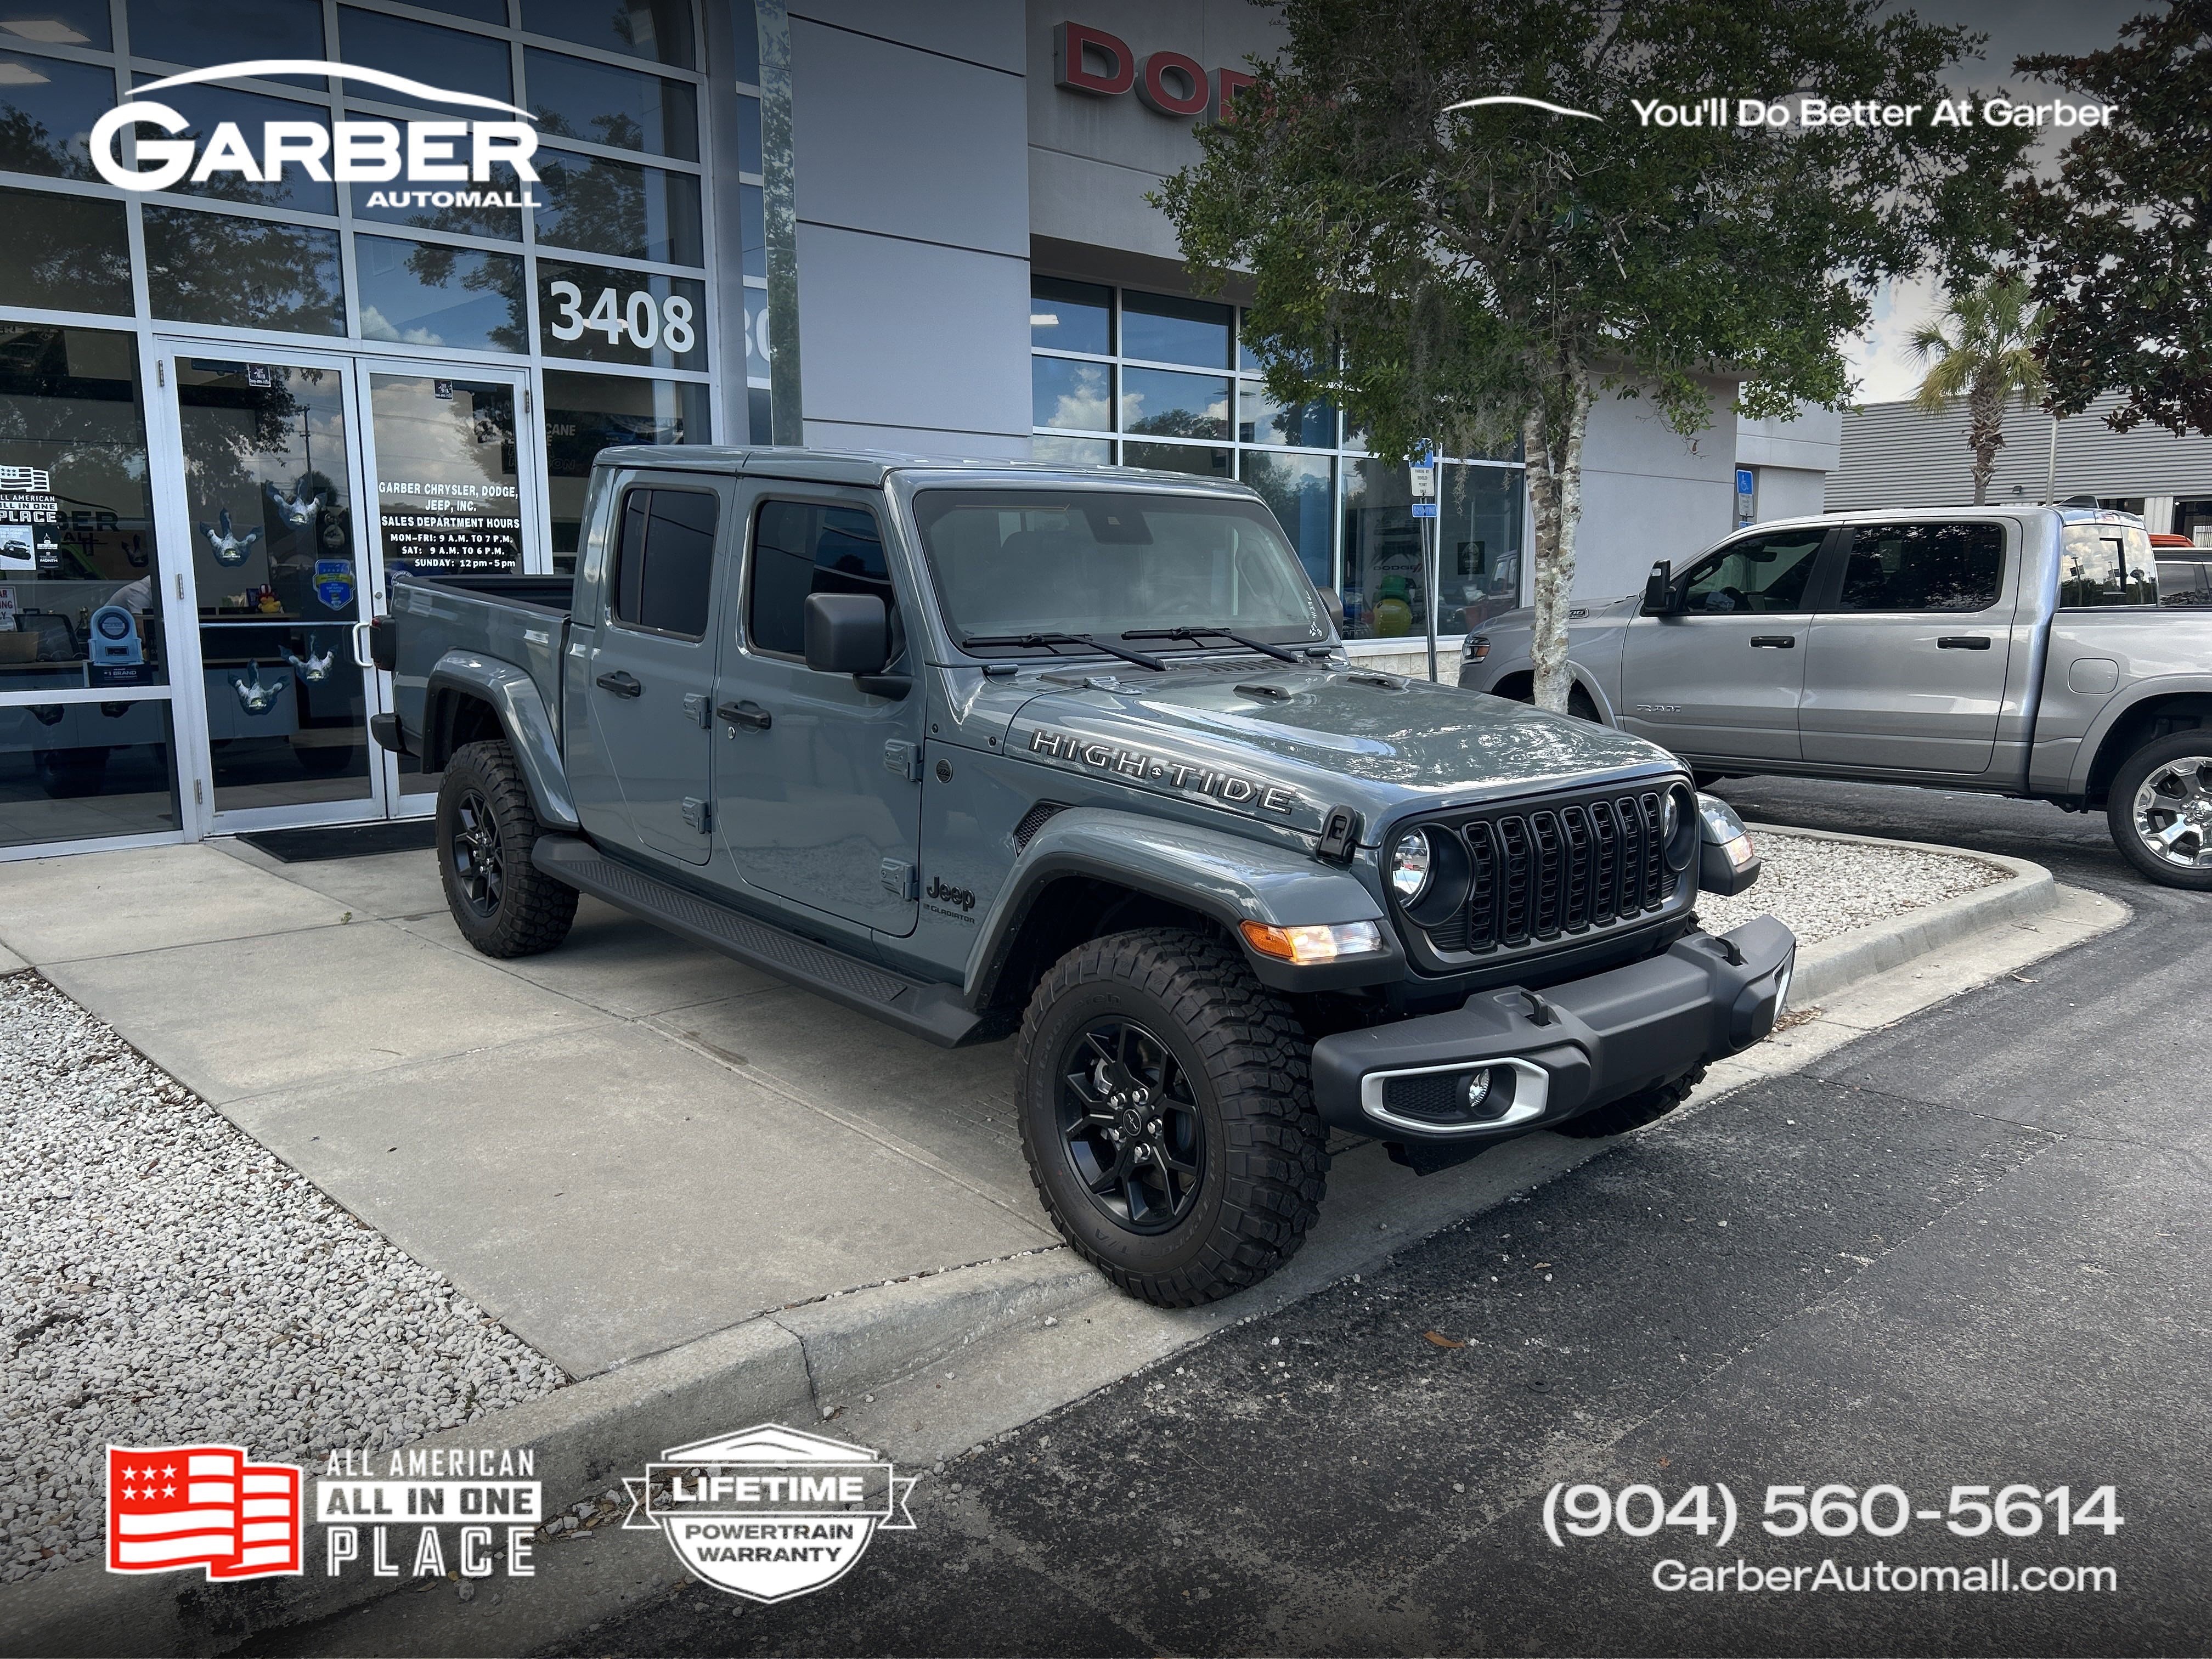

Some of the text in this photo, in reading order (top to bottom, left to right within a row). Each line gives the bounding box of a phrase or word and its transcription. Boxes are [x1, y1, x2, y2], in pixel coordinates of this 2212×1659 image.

[550, 281, 695, 353] 3408
[379, 482, 518, 499] GARBER CHRYSLER, DODGE,
[425, 499, 476, 513] JEEP, INC.
[0, 511, 57, 522] PLACE
[382, 516, 520, 528] SALES DEPARTMENT HOURS
[391, 534, 436, 542] MON-FRI:
[485, 547, 504, 555] P.M.
[415, 559, 455, 567] SUNDAY:
[1029, 728, 1296, 815] HIGH TIDE
[927, 875, 975, 912] Jeep
[930, 905, 975, 924] GLADIATOR
